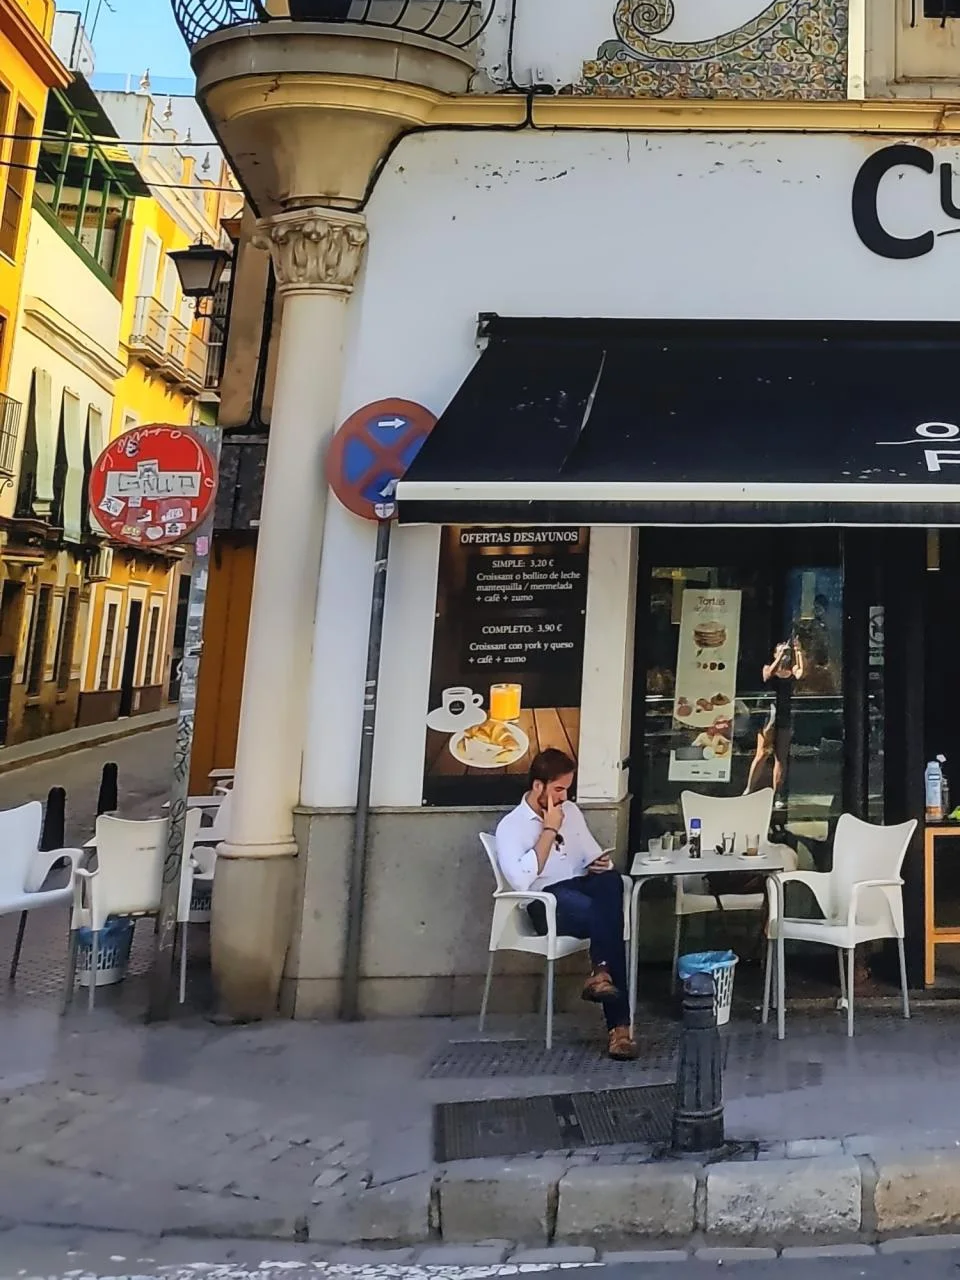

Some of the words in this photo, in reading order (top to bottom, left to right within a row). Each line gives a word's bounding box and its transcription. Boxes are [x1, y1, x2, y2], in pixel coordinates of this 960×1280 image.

[461, 532, 511, 543] OFERTAS
[513, 531, 578, 542] DESAYUNOS
[492, 560, 525, 568] SIMPLE:
[548, 559, 554, 567] €
[476, 573, 514, 581] Croissant
[560, 571, 580, 579] leche
[476, 583, 522, 592] mantequilla
[530, 582, 573, 590] mermelada
[482, 625, 534, 634] COMPLETO:
[556, 624, 563, 632] €
[524, 641, 542, 651] york
[550, 642, 574, 651] queso
